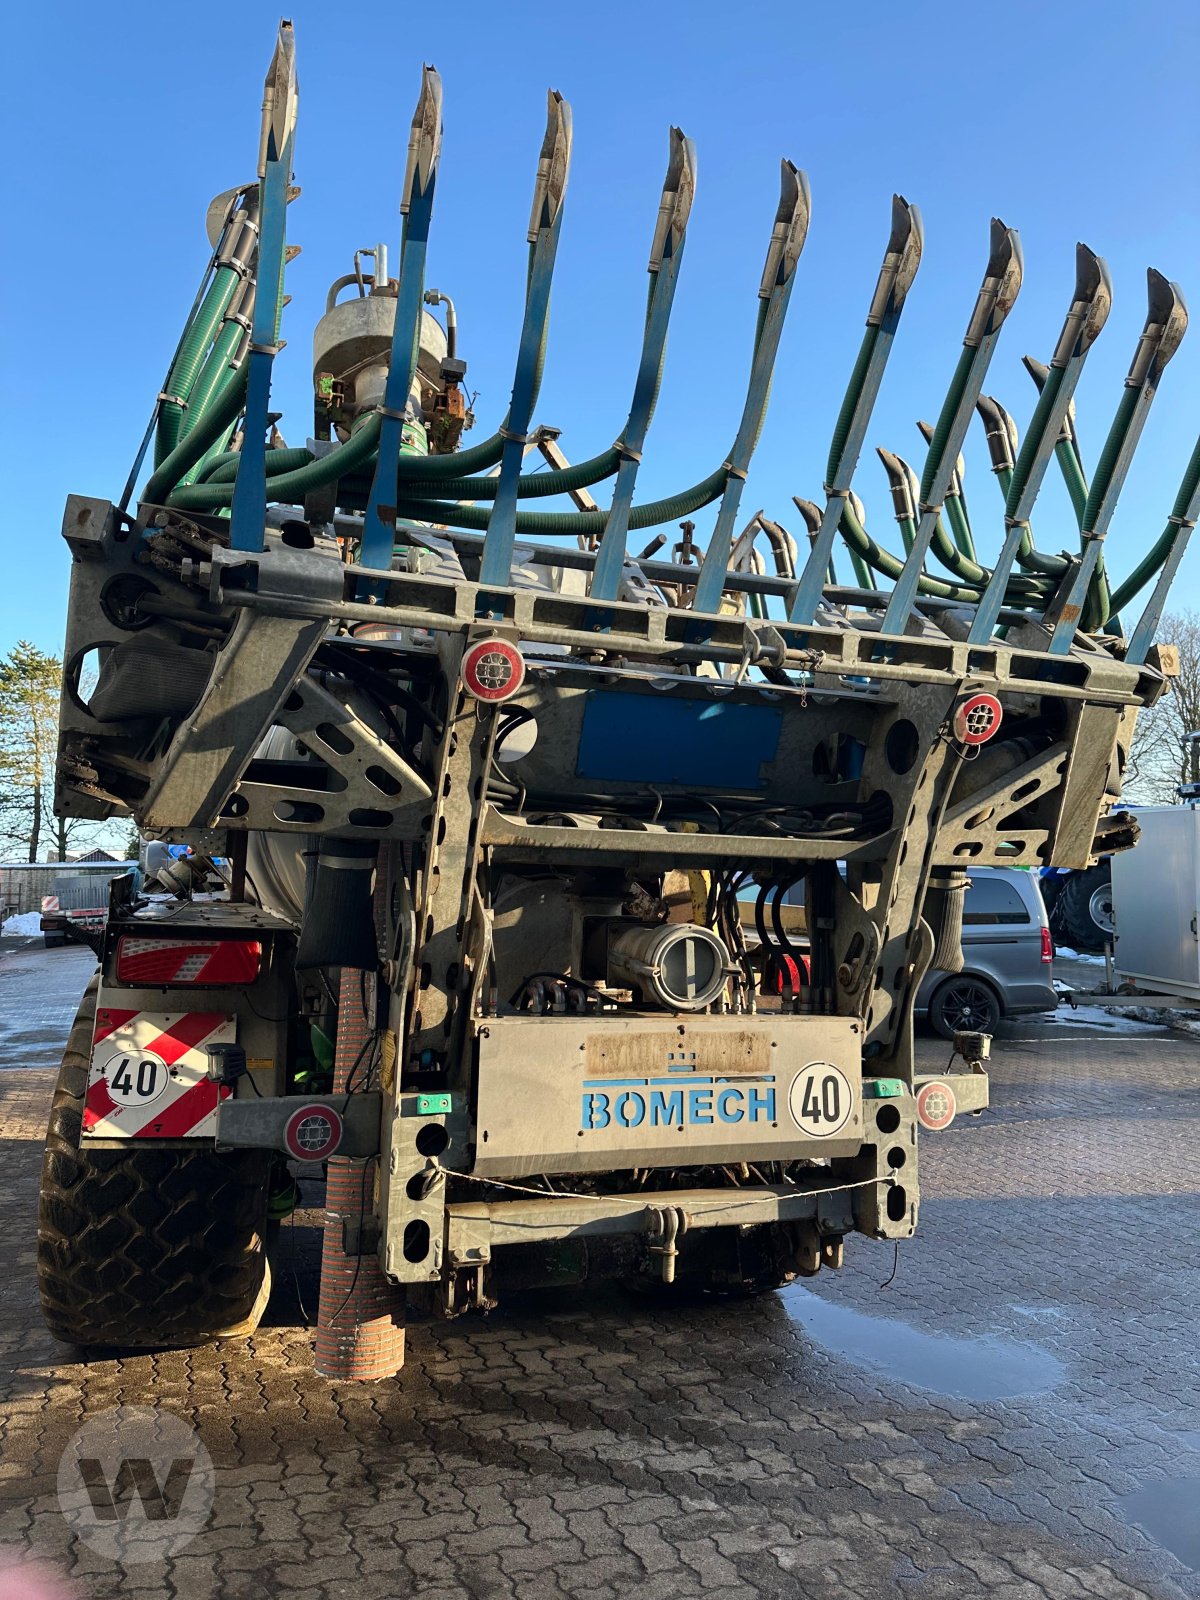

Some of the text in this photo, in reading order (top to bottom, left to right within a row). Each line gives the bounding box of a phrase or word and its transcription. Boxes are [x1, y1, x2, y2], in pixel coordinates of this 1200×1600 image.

[111, 1058, 158, 1097] 40
[581, 1088, 776, 1130] BOMECH
[801, 1075, 840, 1124] 40
